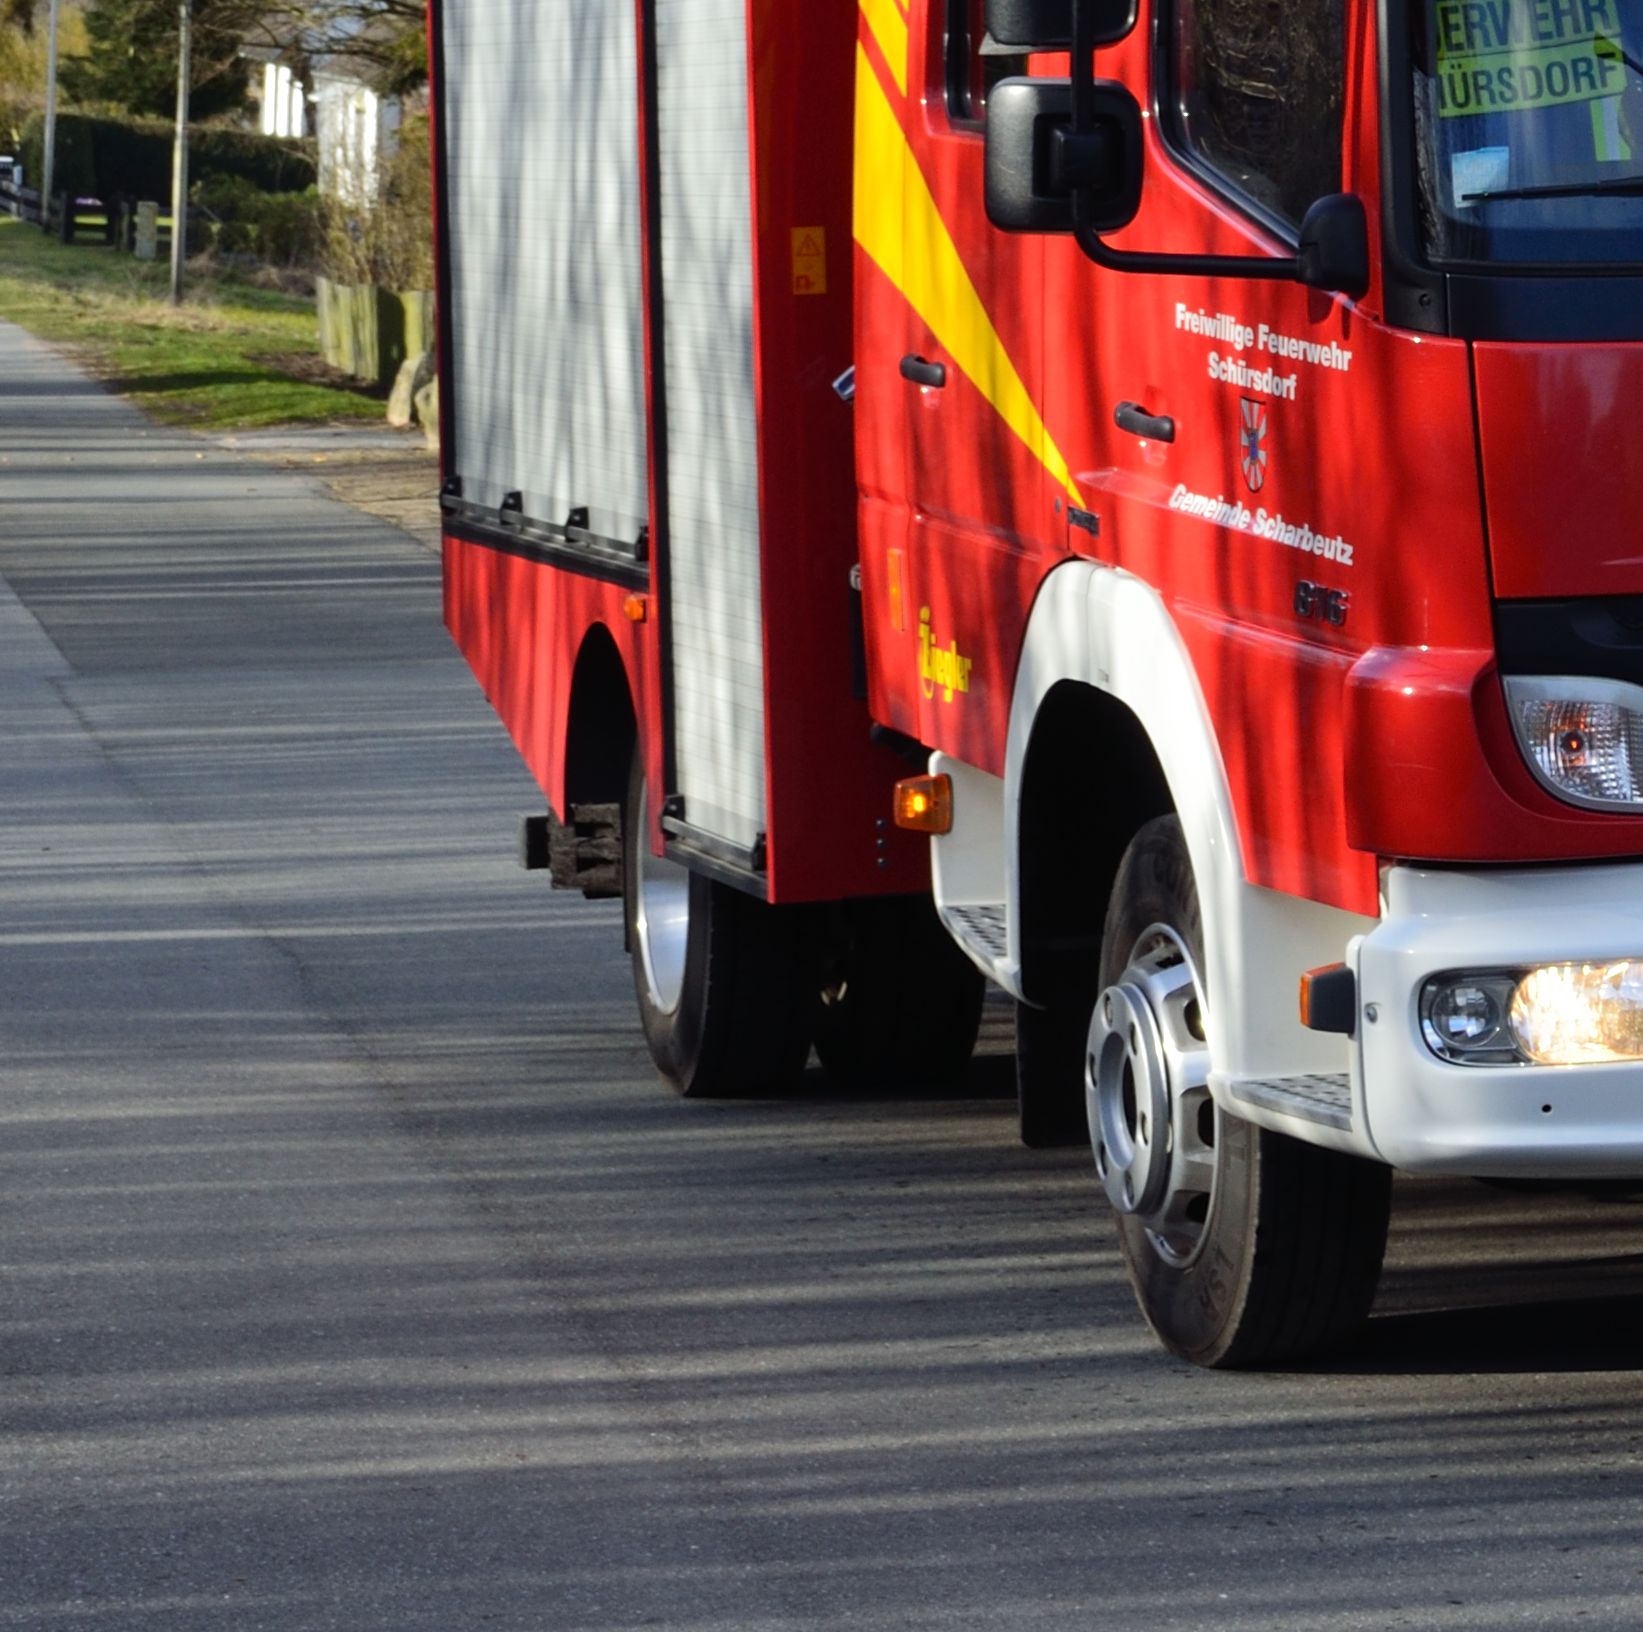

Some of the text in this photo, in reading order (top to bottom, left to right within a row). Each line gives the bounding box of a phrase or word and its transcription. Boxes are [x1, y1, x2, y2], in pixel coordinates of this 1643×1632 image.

[1175, 302, 1352, 371] Freiwillige Feuerwehr
[1208, 351, 1297, 400] Schürsdorf
[1168, 483, 1353, 566] Gemeinde Scharbeutz
